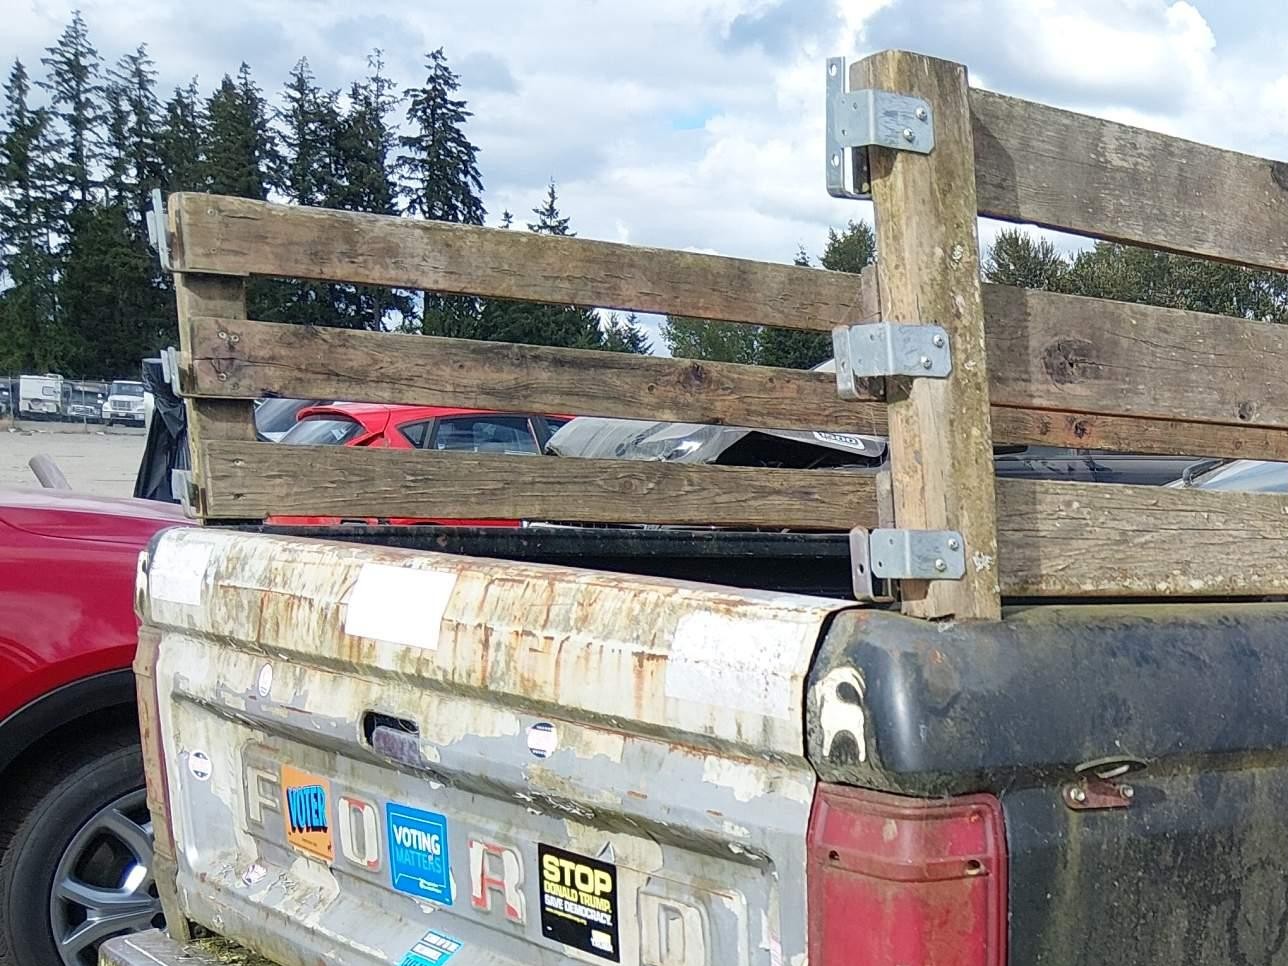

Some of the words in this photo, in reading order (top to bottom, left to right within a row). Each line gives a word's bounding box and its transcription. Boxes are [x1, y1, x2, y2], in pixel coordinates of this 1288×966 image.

[287, 785, 328, 834] VOTER
[393, 824, 441, 855] VOTING
[395, 847, 442, 873] MATTERS
[543, 854, 612, 895] STOP
[543, 880, 578, 903] DONALD
[579, 891, 613, 914] TRUMP.
[544, 894, 564, 910] SAVE
[564, 900, 613, 926] DEMOCRACY.
